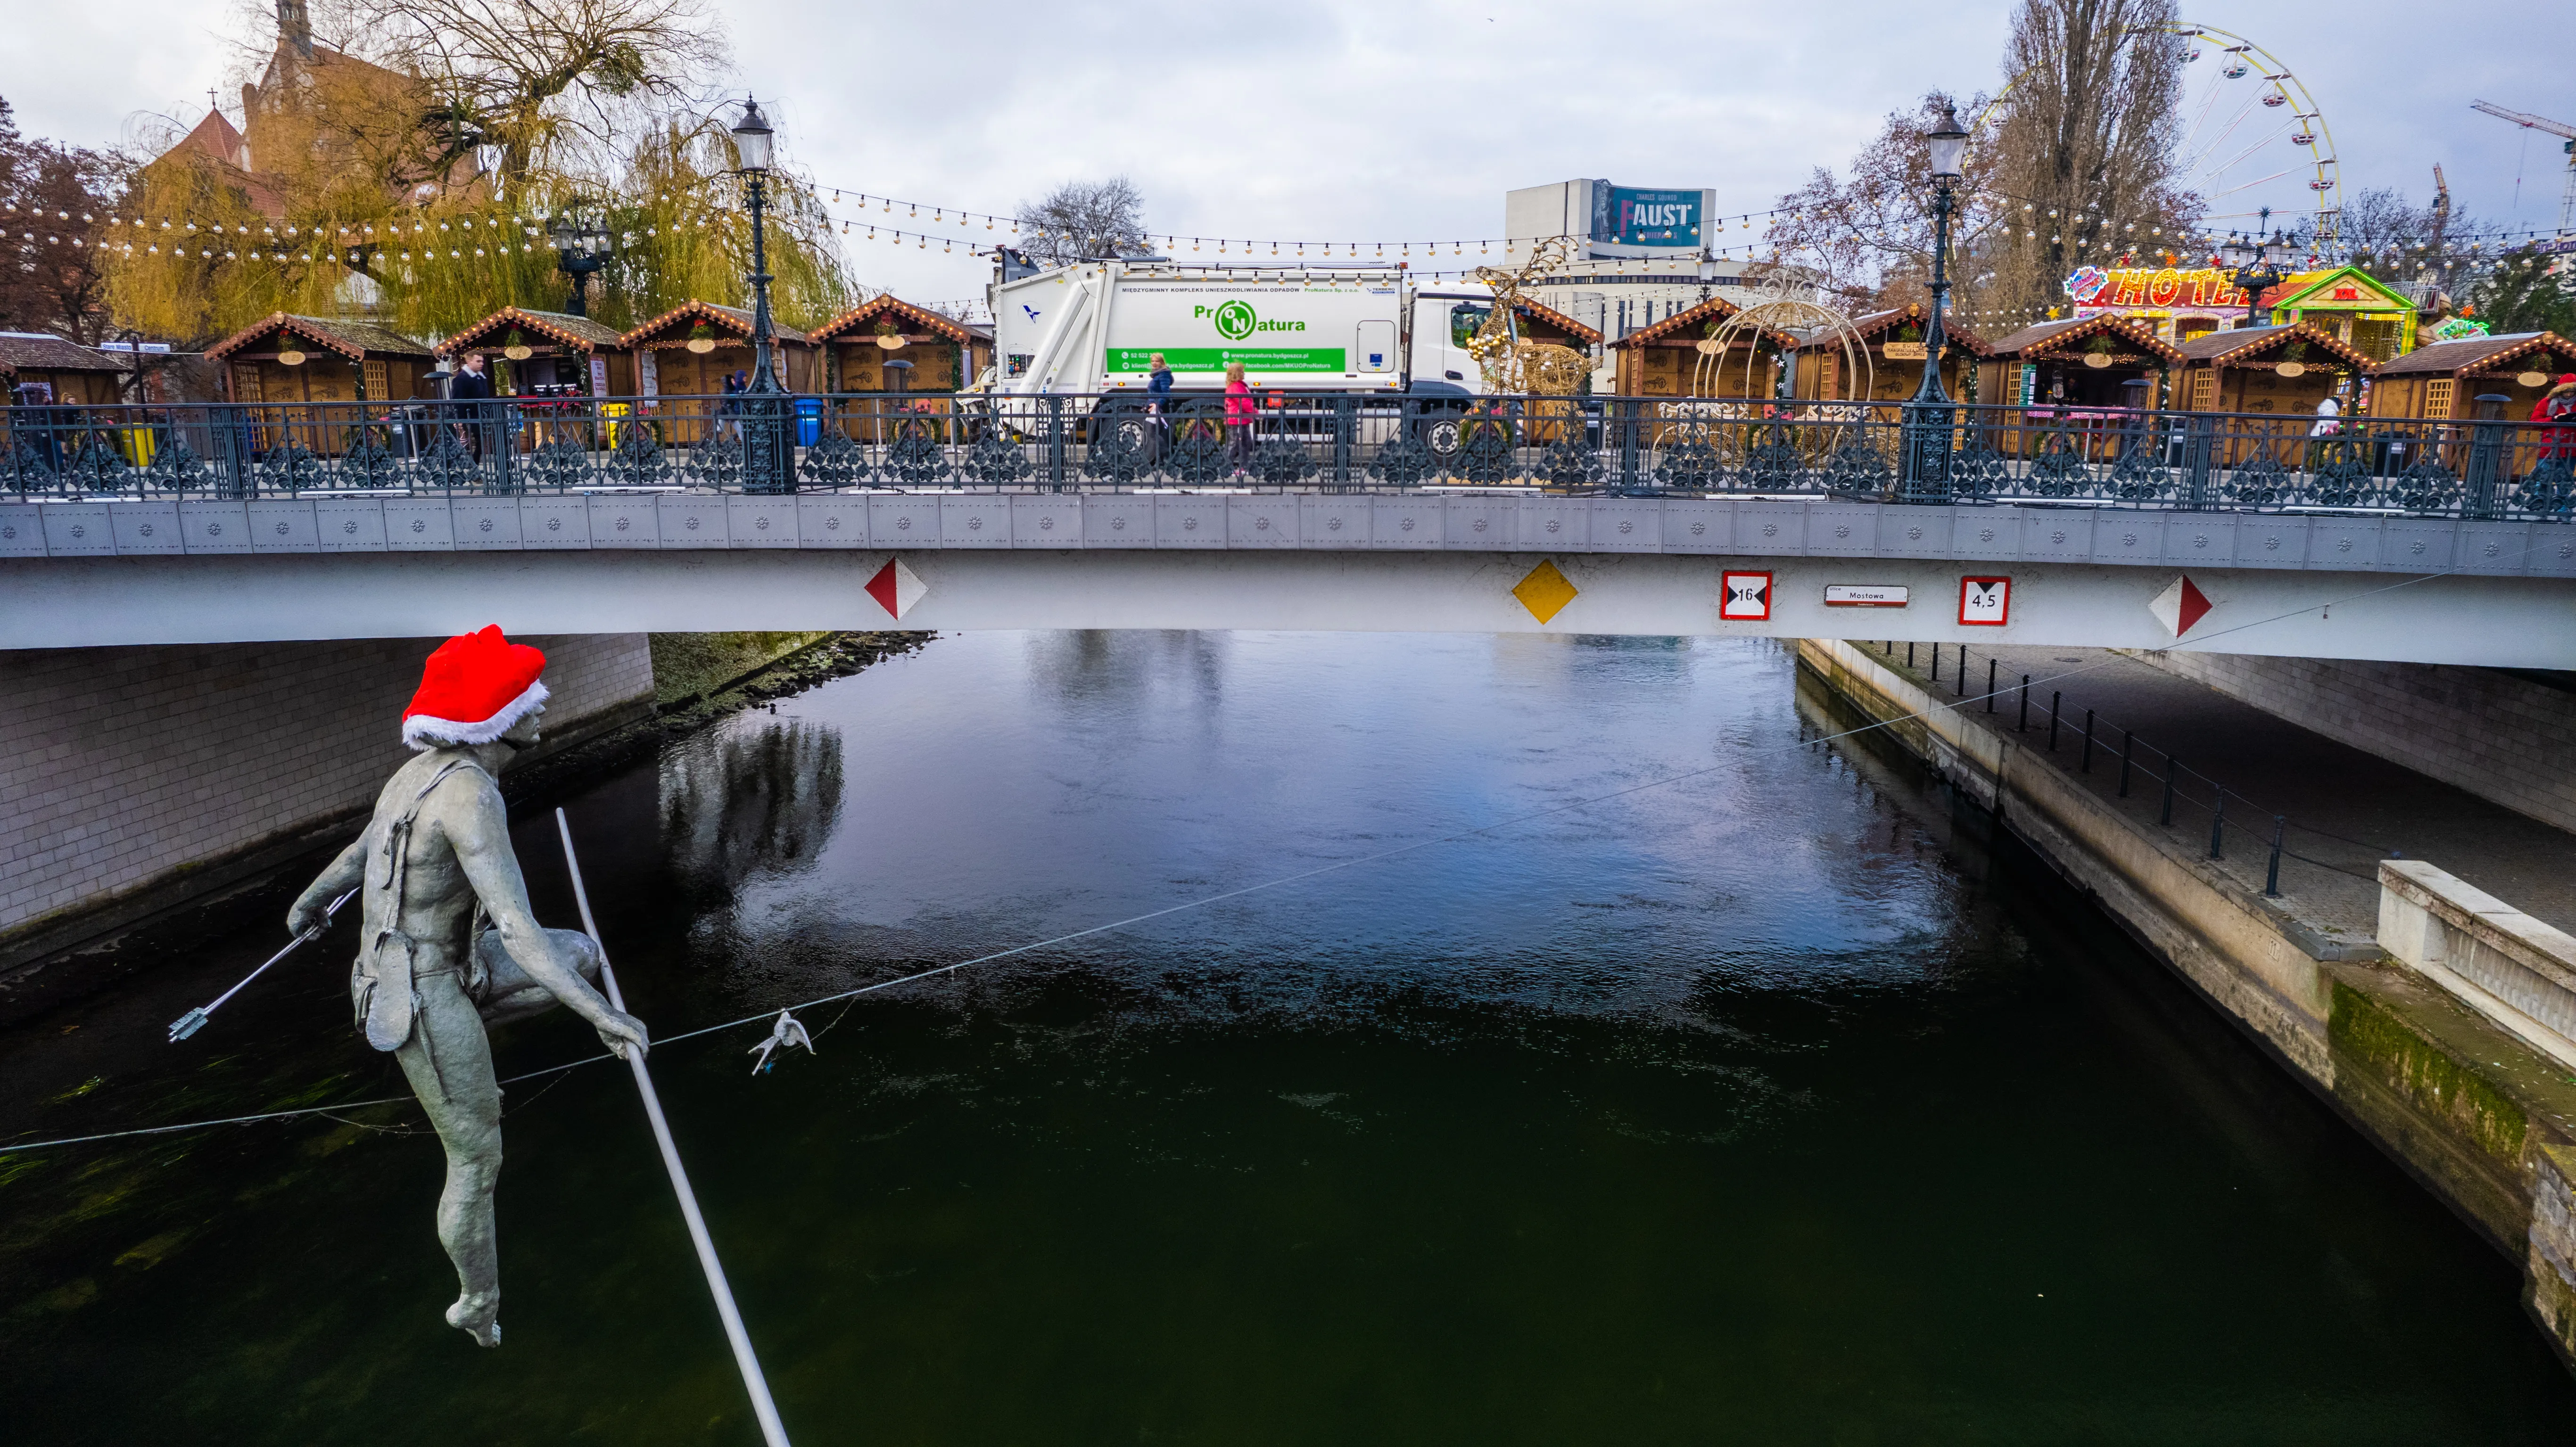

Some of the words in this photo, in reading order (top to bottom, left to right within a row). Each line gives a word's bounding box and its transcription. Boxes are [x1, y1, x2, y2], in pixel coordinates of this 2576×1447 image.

[1620, 199, 1692, 238] FAUST
[2333, 288, 2358, 300] XXL
[1739, 588, 1753, 601] 16
[1972, 594, 1996, 608] 4,5
